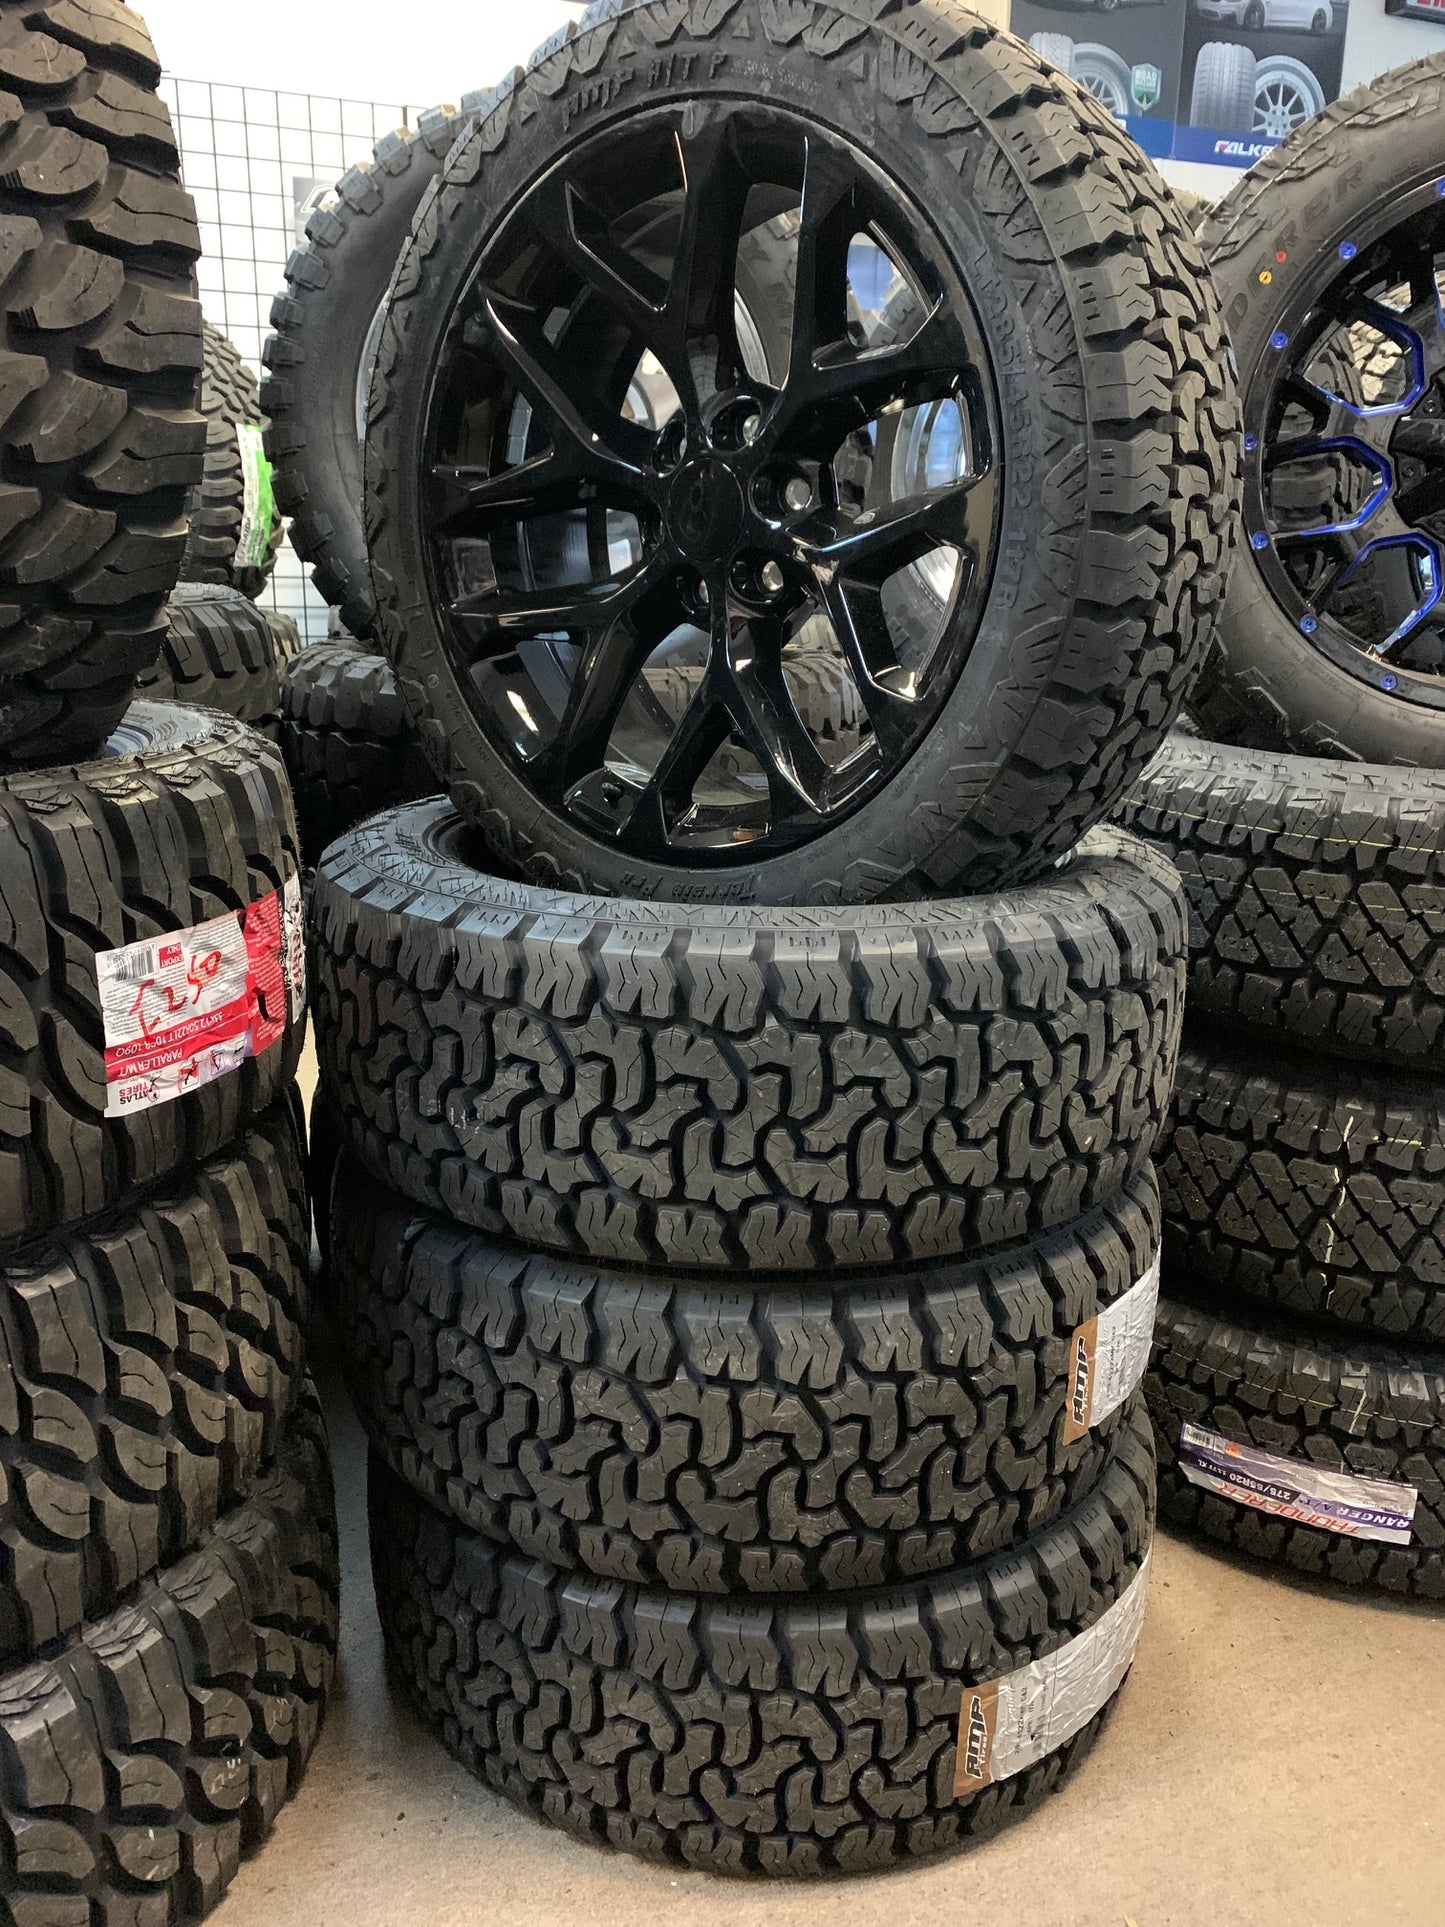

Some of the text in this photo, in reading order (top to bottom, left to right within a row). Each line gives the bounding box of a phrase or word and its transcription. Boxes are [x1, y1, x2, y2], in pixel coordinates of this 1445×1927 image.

[139, 1048, 183, 1071] PARALLER
[119, 1082, 148, 1097] TIRES
[119, 1090, 149, 1105] ATLAS
[1072, 1335, 1089, 1426] AMP
[1229, 1472, 1291, 1500] 275/55R20
[1219, 1483, 1361, 1535] THUNDERER
[1336, 1507, 1409, 1528] RANGER
[965, 1694, 987, 1779] AMP
